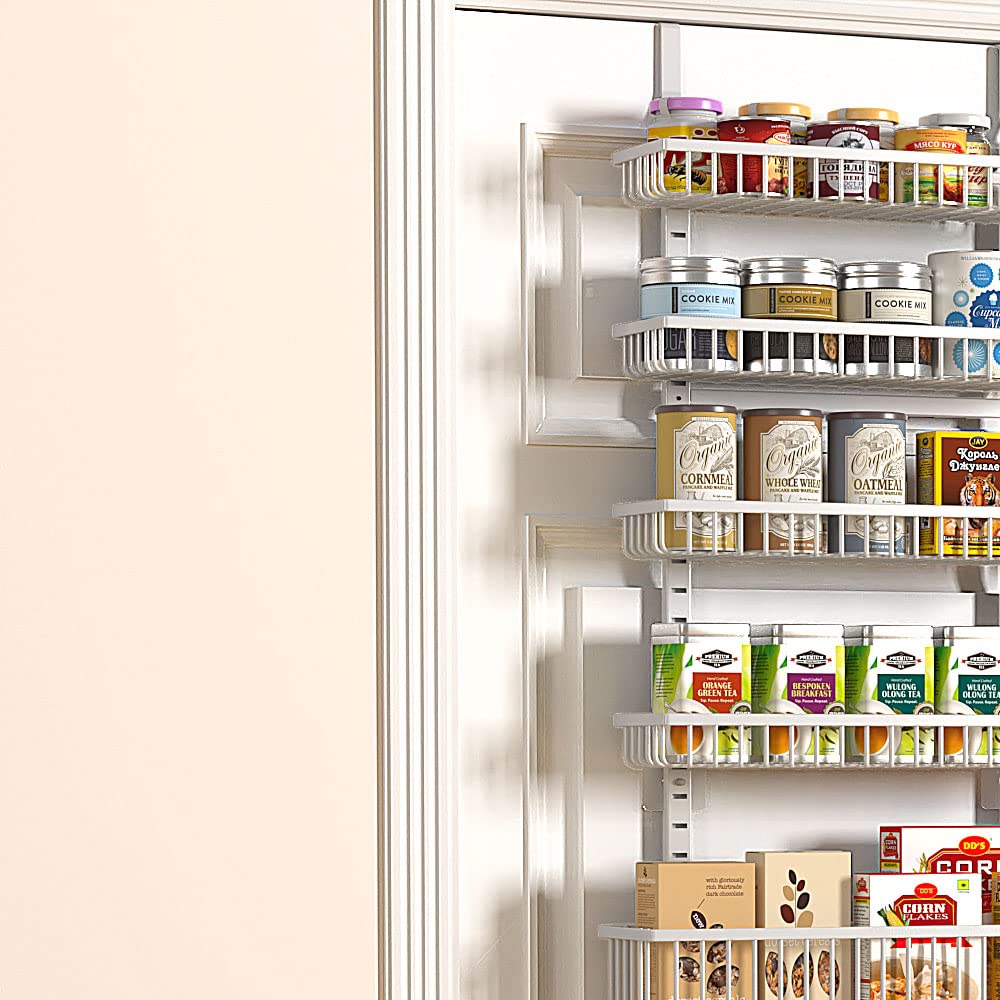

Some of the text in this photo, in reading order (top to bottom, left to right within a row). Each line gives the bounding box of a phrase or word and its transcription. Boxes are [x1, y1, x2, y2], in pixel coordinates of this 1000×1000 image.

[914, 141, 940, 149] МЯСО
[681, 294, 720, 304] COOKIE
[778, 296, 817, 304] COOKIE
[874, 300, 927, 310] COOKIE MIX
[680, 432, 732, 471] Organic
[766, 435, 818, 475] Organic
[957, 448, 999, 462] Король
[851, 438, 902, 477] Organic
[681, 473, 733, 486] CORNMEAL
[765, 478, 798, 488] WHOLE
[854, 478, 902, 490] OATMEAL
[698, 689, 737, 697] GREEN TEA
[791, 690, 832, 698] BREAKFAST
[964, 842, 986, 850] DD'S
[902, 903, 947, 914] CORN
